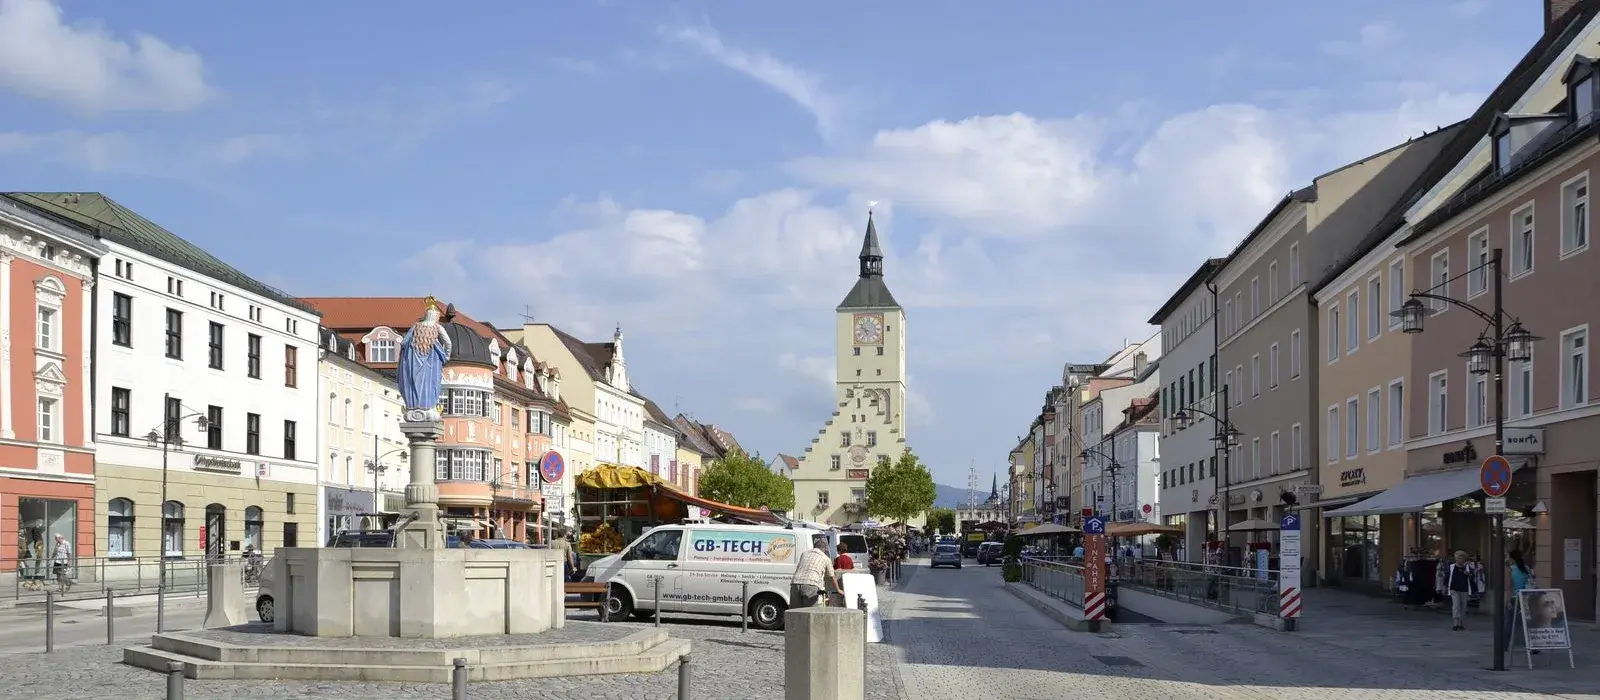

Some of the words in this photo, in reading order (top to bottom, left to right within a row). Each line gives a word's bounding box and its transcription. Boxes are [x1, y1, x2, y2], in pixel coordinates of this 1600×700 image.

[1508, 433, 1538, 445] BONITA
[1092, 521, 1099, 531] P
[1287, 518, 1294, 526] P
[694, 539, 762, 553] GB-TECH
[662, 593, 744, 603] www.gb-tech-gmbh.de
